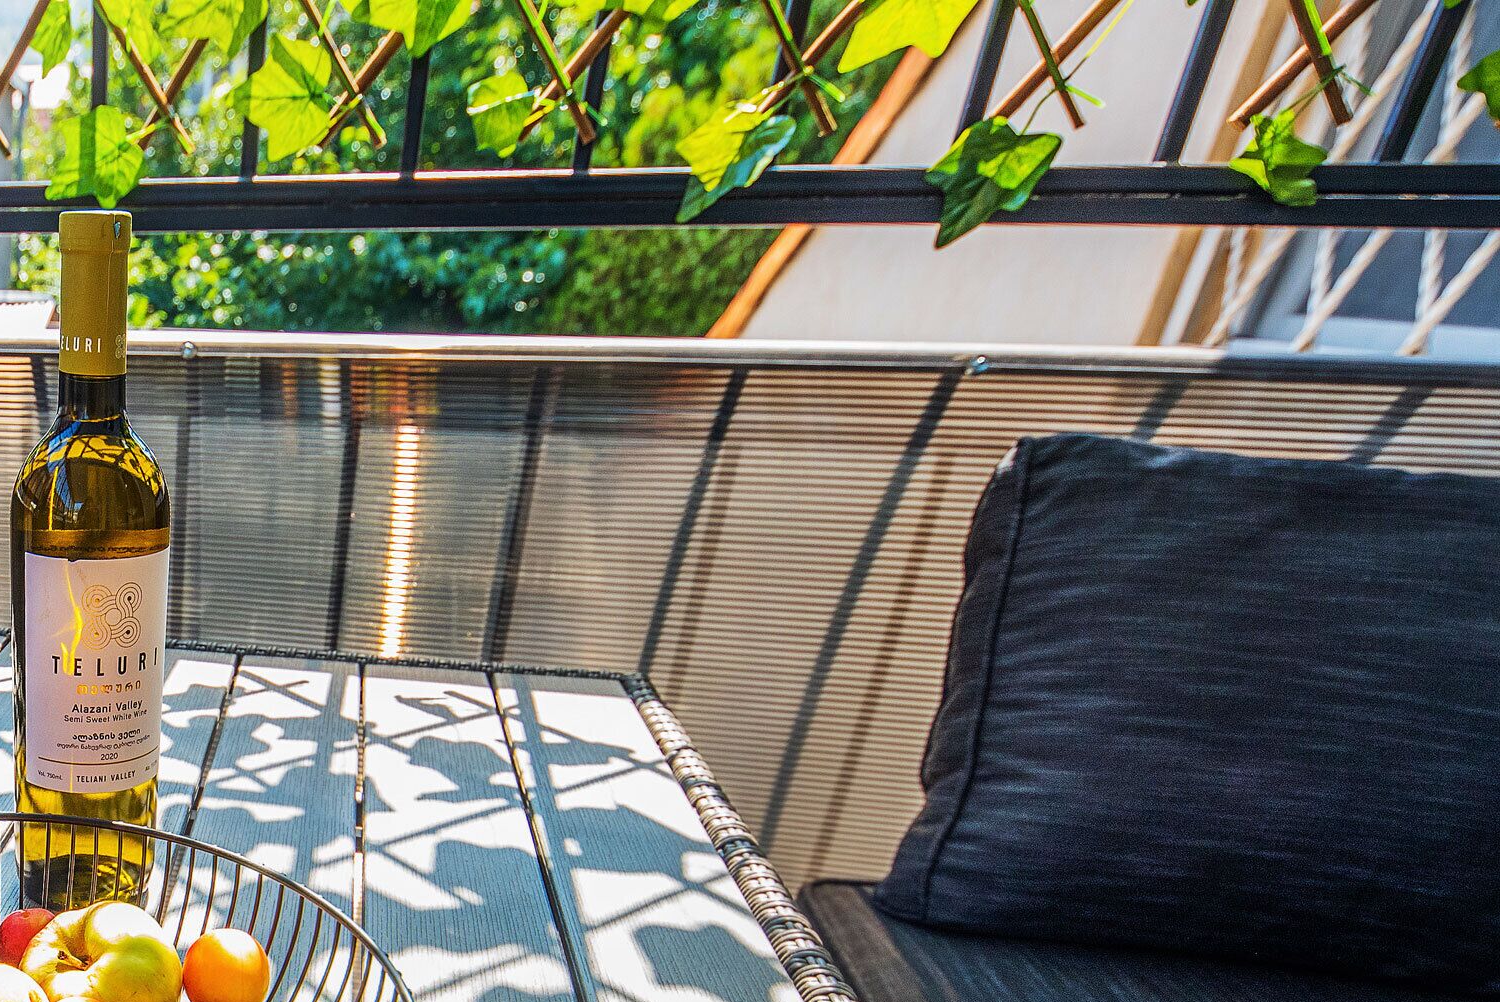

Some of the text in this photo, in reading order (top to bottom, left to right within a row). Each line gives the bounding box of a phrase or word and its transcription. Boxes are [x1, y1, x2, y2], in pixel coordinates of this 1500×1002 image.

[51, 647, 158, 677] TELURI
[72, 700, 143, 713] Alazani Valley
[64, 709, 148, 723] Semi Sweet White Wine
[100, 752, 119, 761] 2020
[76, 770, 136, 783] TELIANI VALLEY
